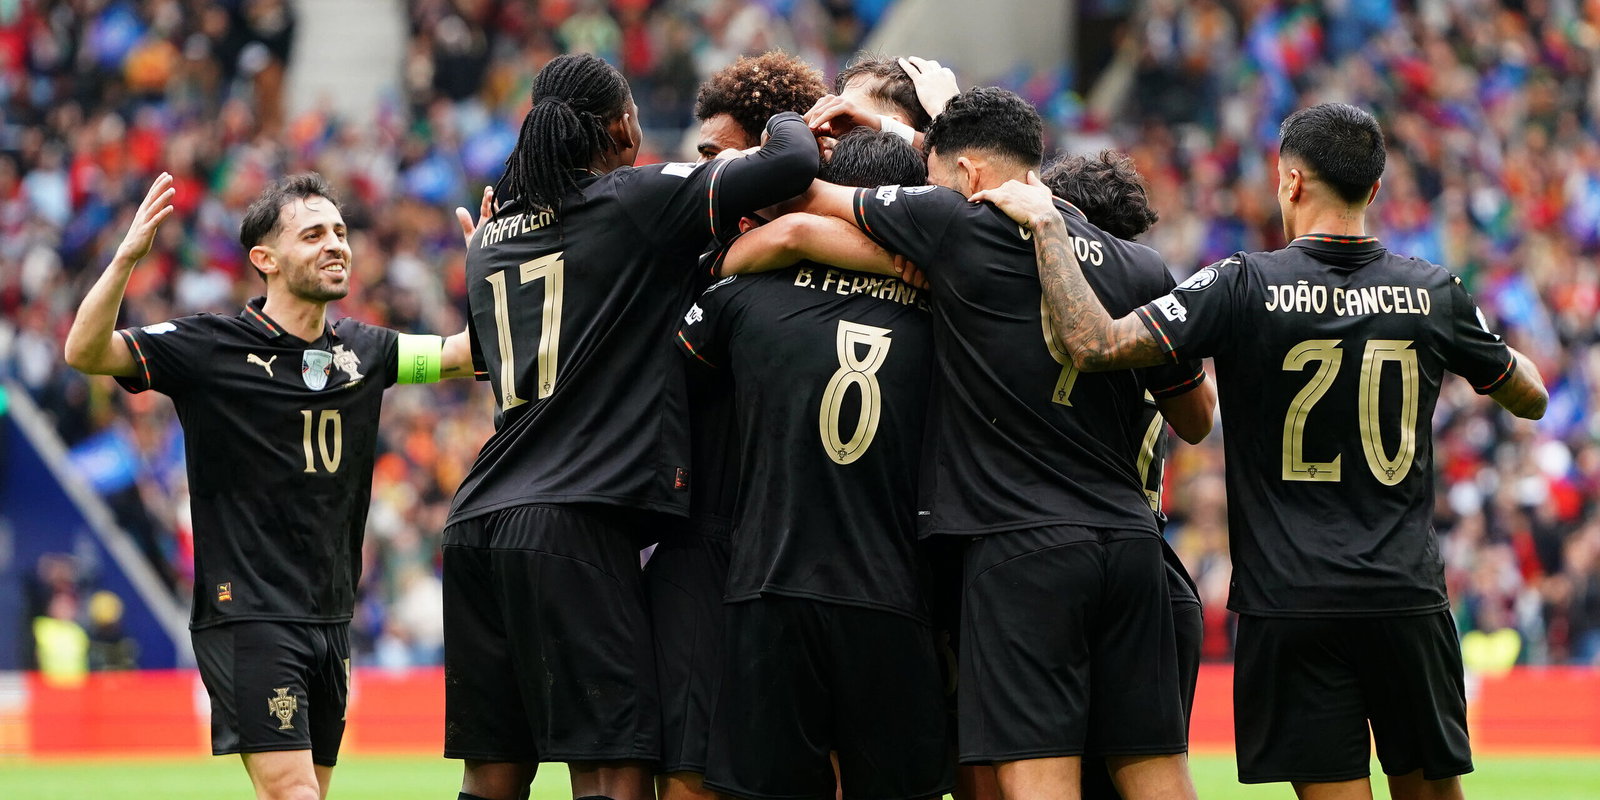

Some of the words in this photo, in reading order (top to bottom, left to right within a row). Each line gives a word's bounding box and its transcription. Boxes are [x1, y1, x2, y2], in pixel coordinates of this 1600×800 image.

[480, 213, 524, 249] RAFA
[793, 266, 816, 289] B.
[1264, 280, 1328, 314] JOÃO
[1333, 285, 1431, 317] CANCELO
[485, 251, 564, 412] 17
[415, 355, 425, 384] ESPECT
[819, 319, 893, 465] 8
[1282, 339, 1419, 486] 20
[300, 409, 342, 473] 10
